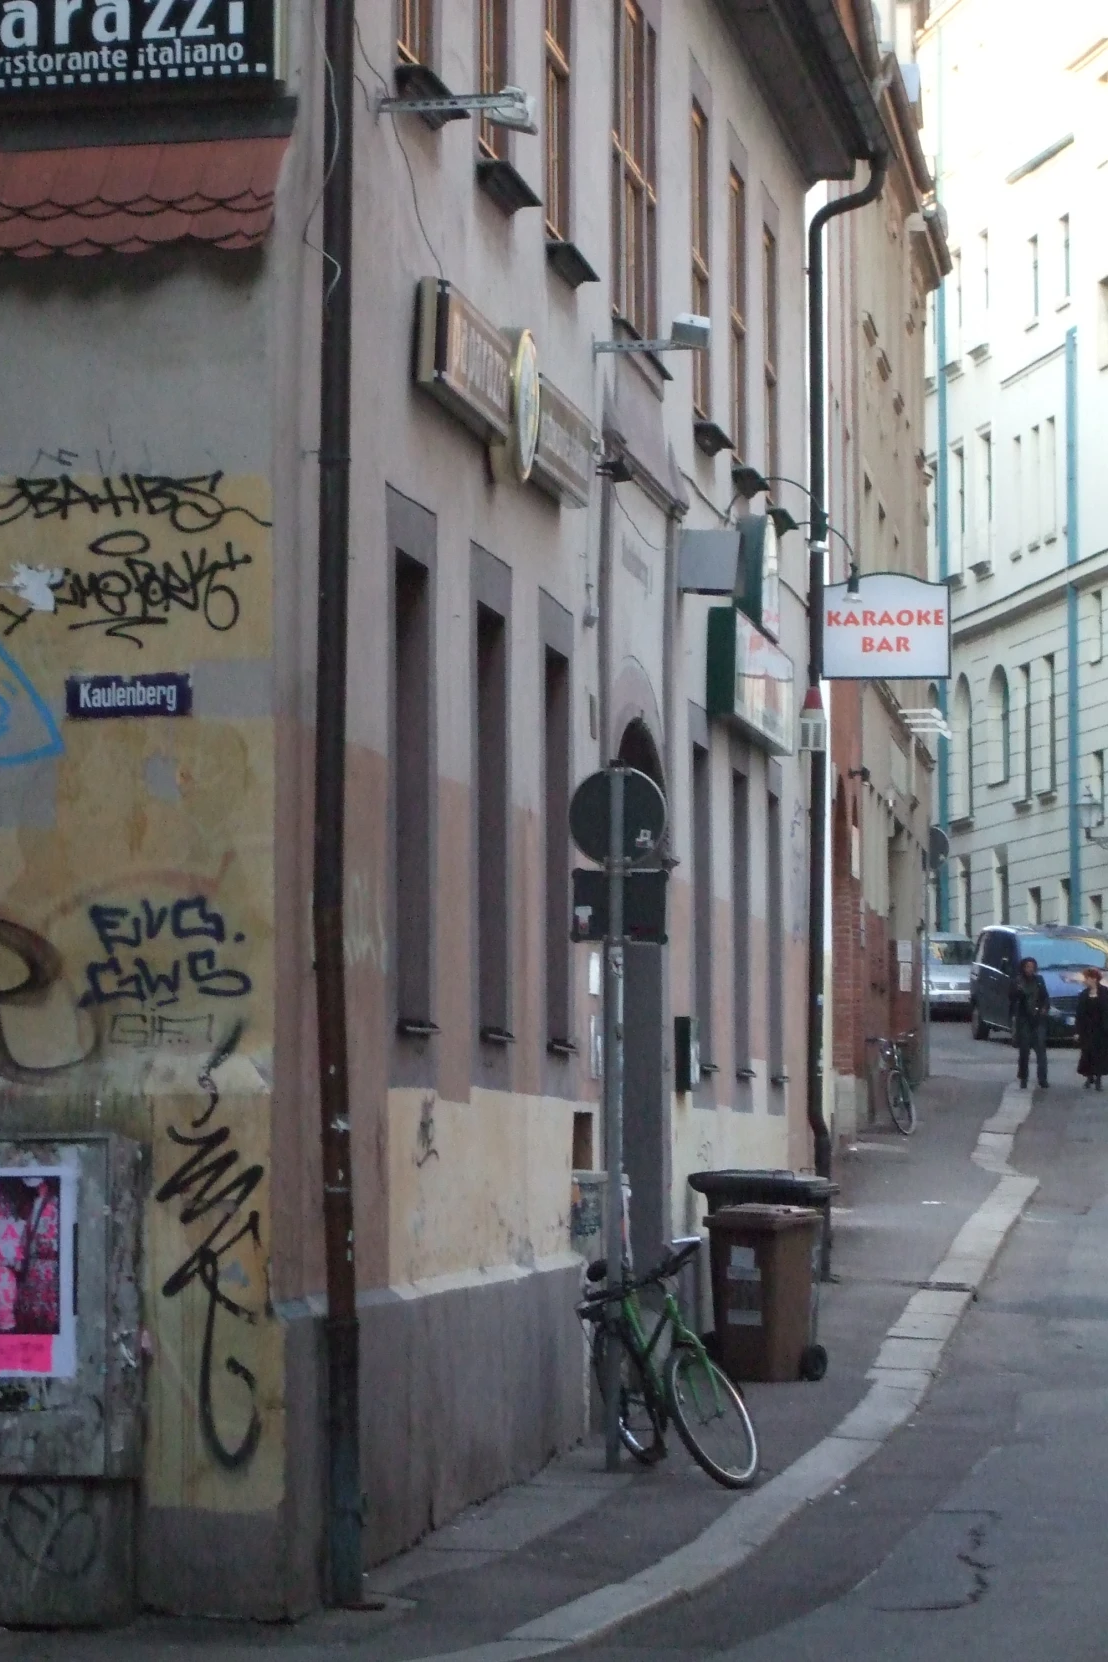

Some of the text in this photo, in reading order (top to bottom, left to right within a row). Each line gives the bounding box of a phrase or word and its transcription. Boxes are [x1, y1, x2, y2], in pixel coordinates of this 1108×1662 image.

[137, 38, 245, 67] italiano
[827, 609, 945, 627] KARAOKE
[861, 636, 911, 653] BAR
[79, 680, 177, 712] Kaulenberg
